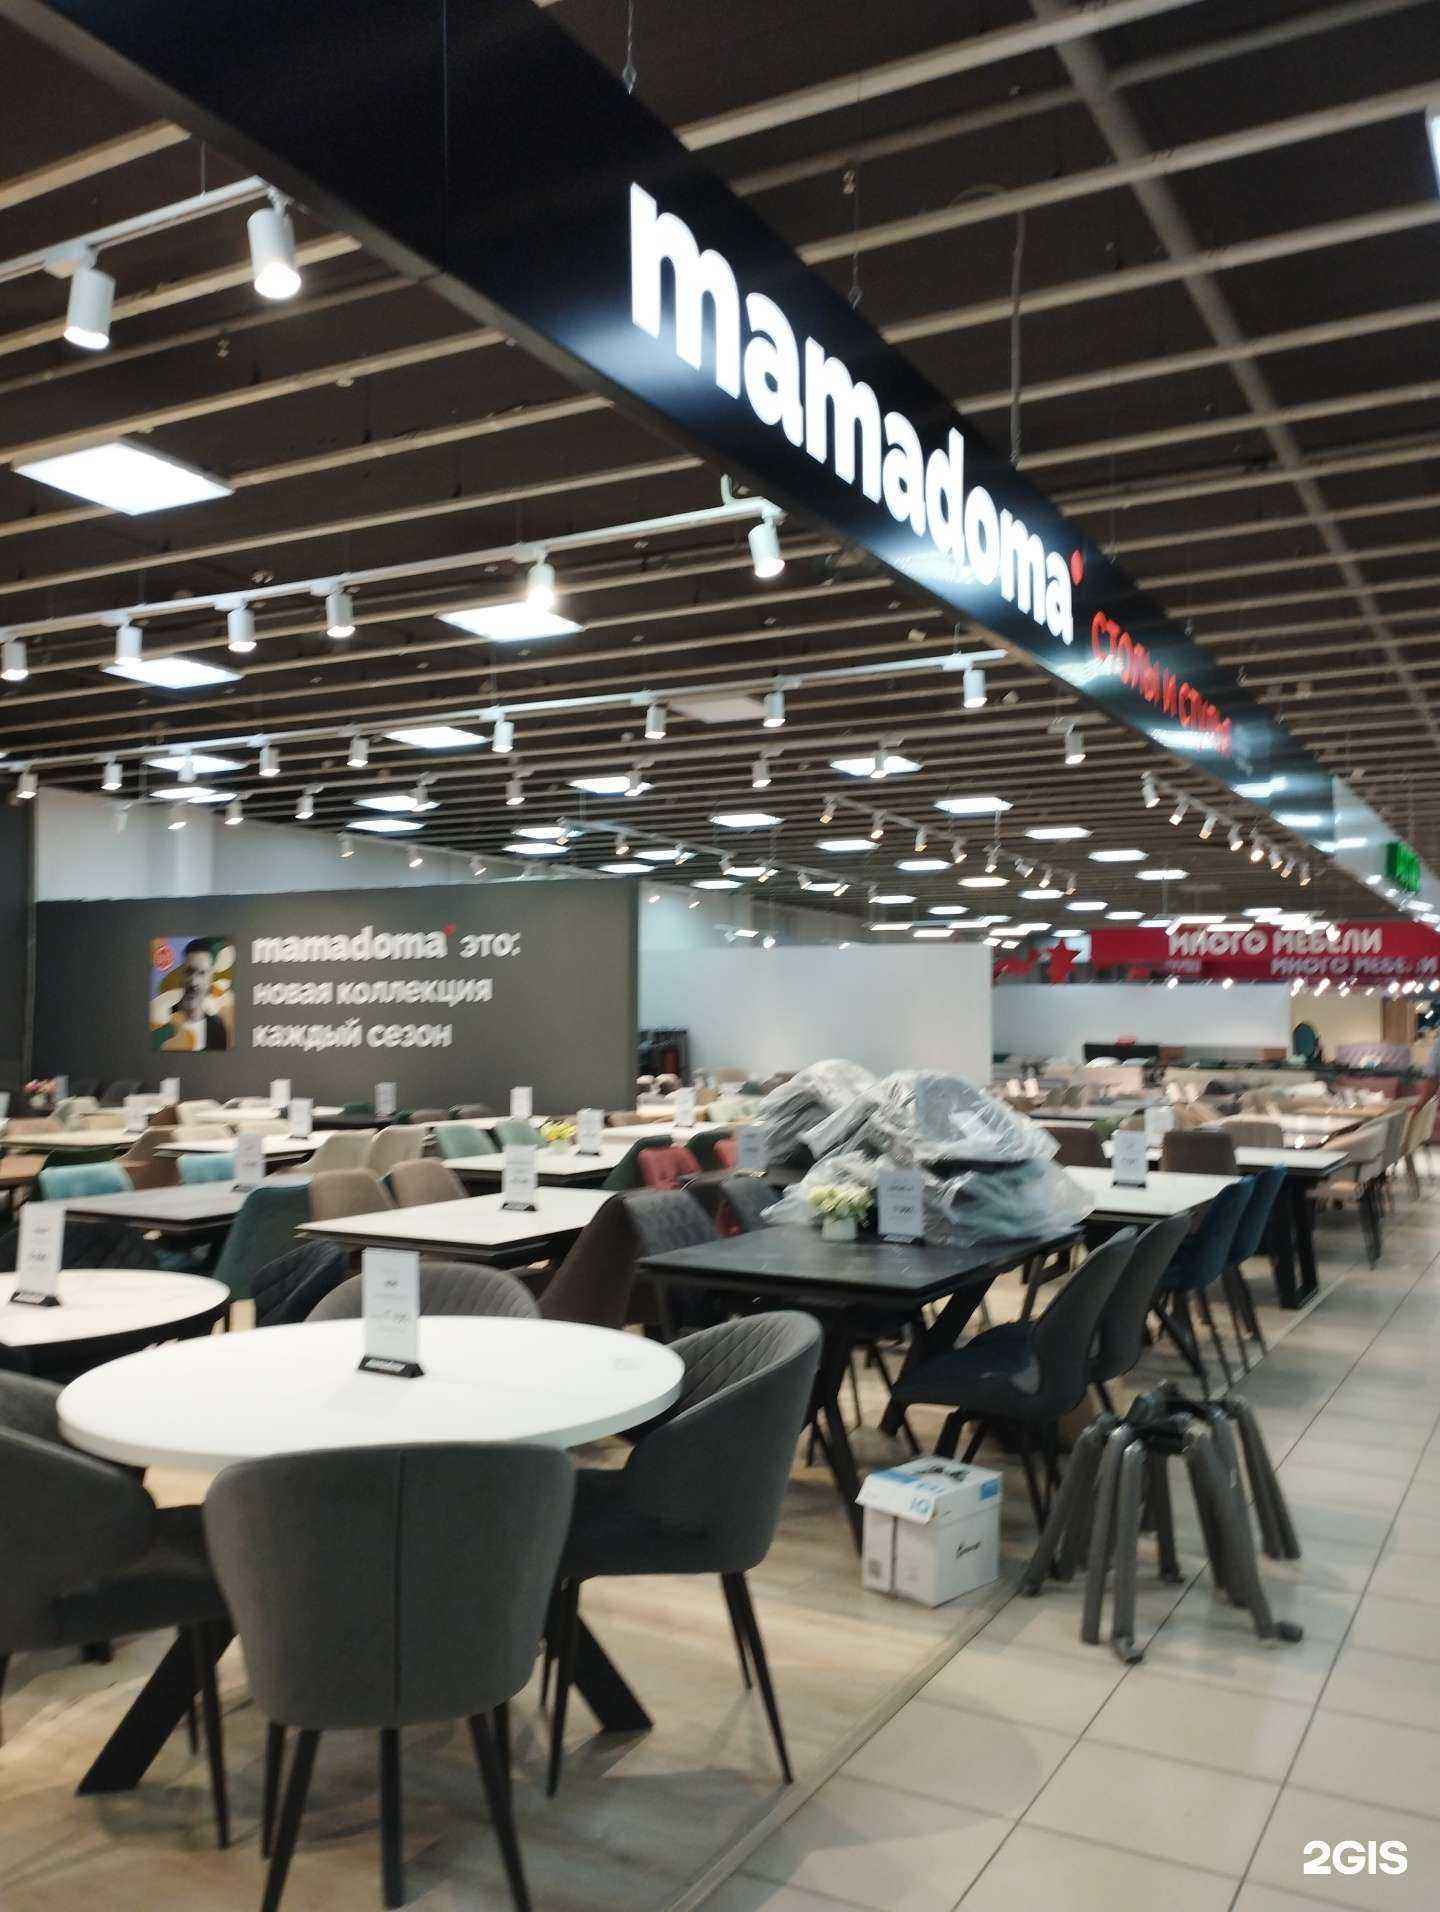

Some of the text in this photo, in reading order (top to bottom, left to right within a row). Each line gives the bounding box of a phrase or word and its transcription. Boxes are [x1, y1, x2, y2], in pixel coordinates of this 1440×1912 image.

[456, 932, 521, 958] это:
[252, 977, 493, 1008] новая коллекция
[252, 1016, 453, 1052] каждый сезон
